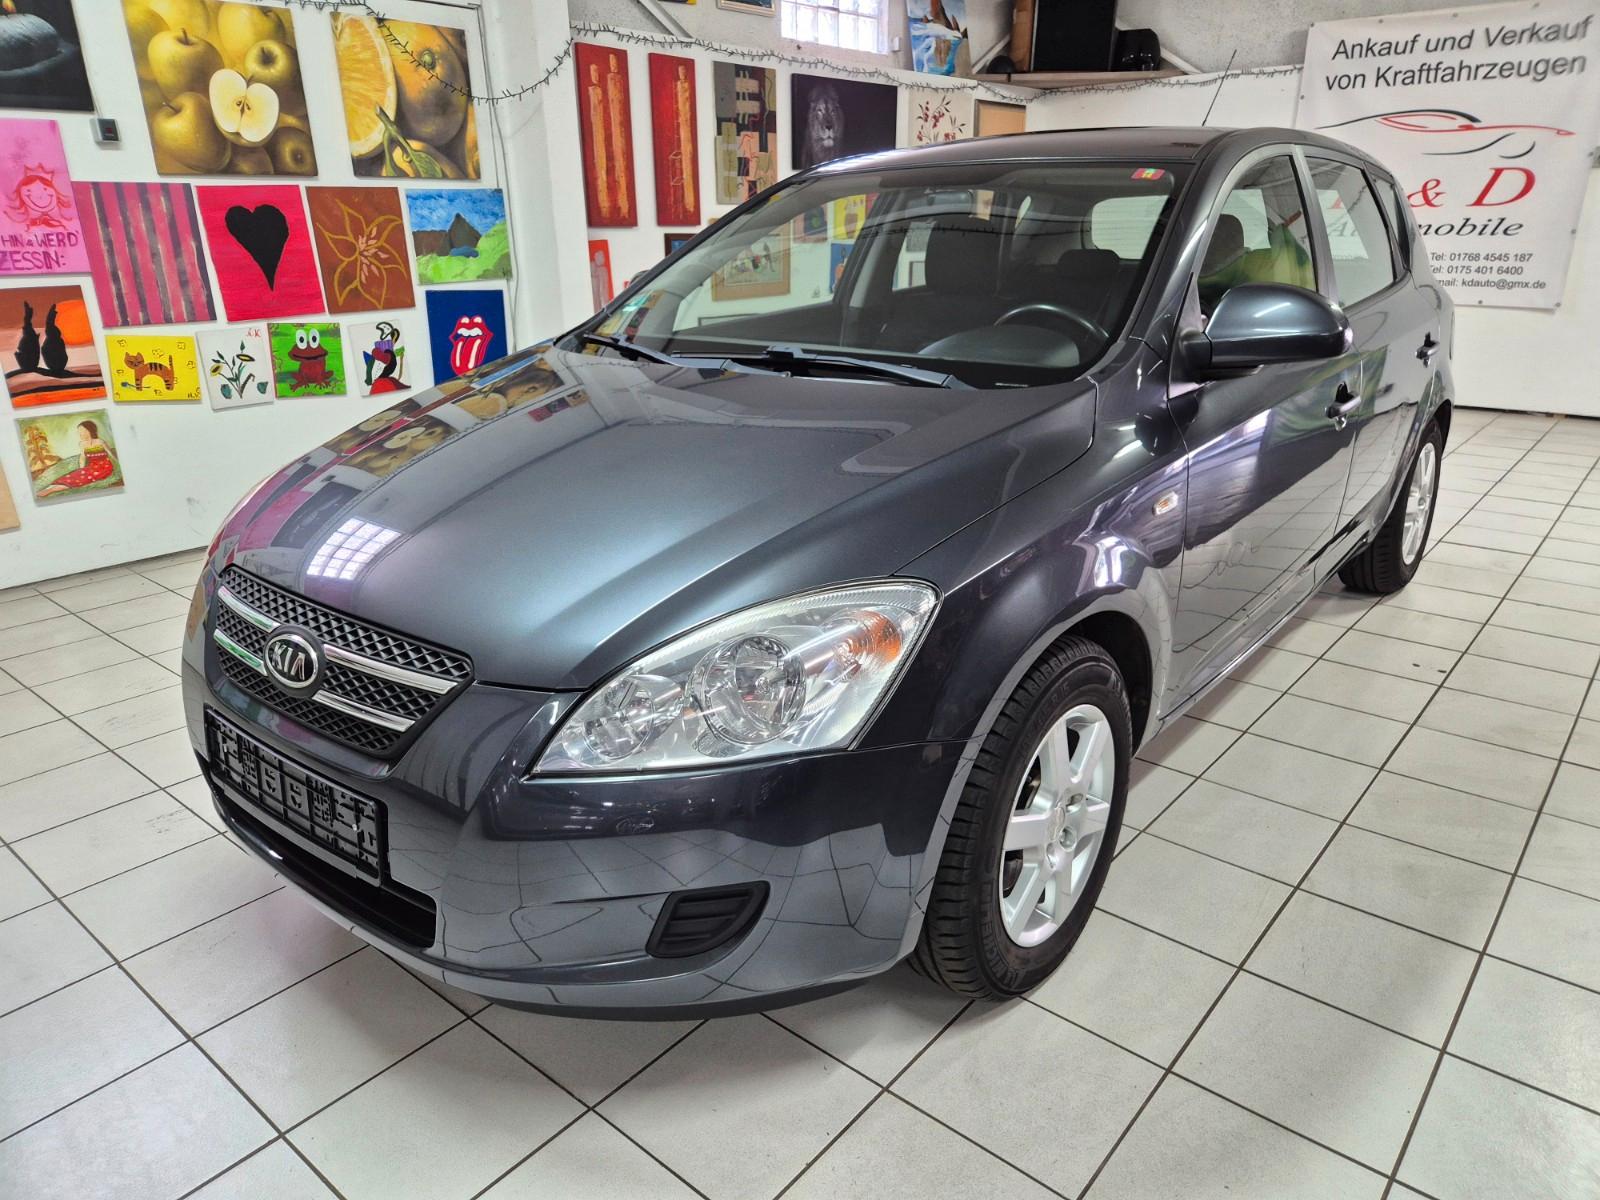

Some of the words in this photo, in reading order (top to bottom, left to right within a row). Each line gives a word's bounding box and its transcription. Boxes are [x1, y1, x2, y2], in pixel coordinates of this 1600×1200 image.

[1332, 34, 1421, 60] Ankauf
[1425, 29, 1475, 53] und
[1485, 14, 1594, 48] Verkauf
[1326, 72, 1366, 90] von
[1374, 54, 1587, 88] Kraftfahrzeugen
[1407, 178, 1446, 208] &
[1466, 167, 1536, 207] D
[1430, 265, 1444, 274] el:
[1447, 265, 1472, 275] 0175
[1474, 265, 1494, 275] 401
[1497, 265, 1524, 276] 6400
[1431, 252, 1446, 262] Tel:
[1450, 252, 1481, 262] 01768
[1483, 252, 1511, 263] 4545
[1513, 253, 1534, 263] 187
[1461, 278, 1546, 290] kdauto@gmx.de
[271, 641, 306, 680] KIA
